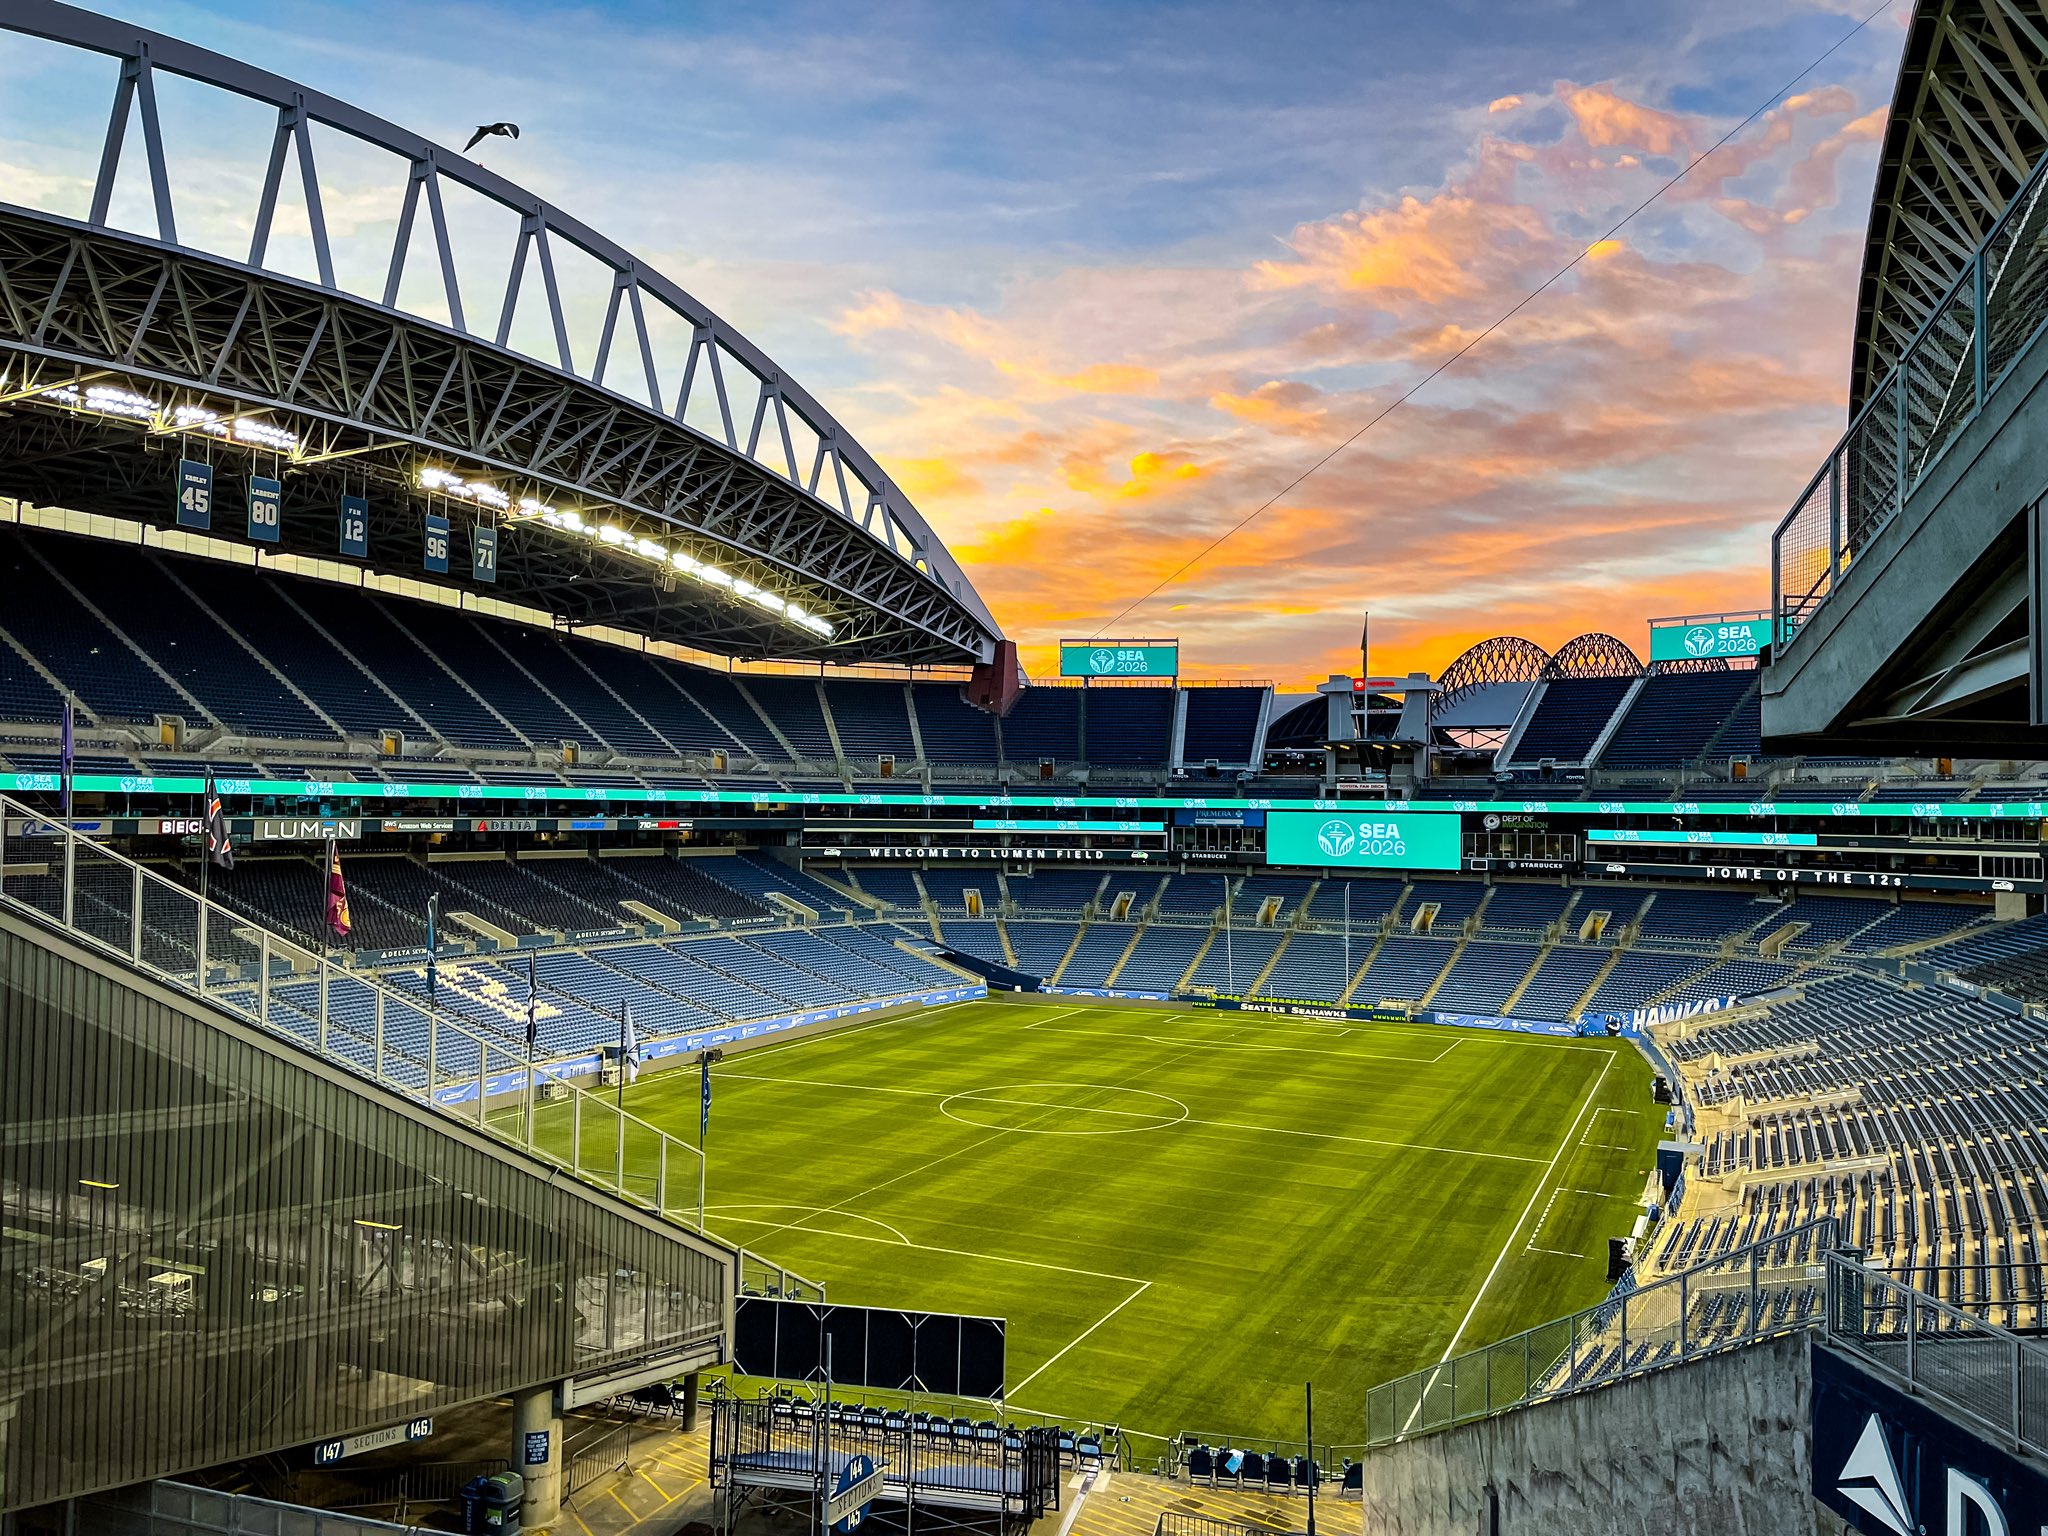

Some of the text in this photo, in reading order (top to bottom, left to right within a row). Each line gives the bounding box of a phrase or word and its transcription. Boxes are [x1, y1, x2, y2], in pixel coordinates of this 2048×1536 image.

[181, 487, 208, 513] 45
[252, 501, 276, 526] 80
[345, 519, 364, 542] 12
[427, 537, 447, 560] 96
[478, 548, 493, 570] 71
[1718, 626, 1752, 640] SEA
[1718, 638, 1756, 652] 2026
[1117, 651, 1144, 661] SEA
[1117, 662, 1148, 672] 2026
[264, 822, 355, 838] LUMEN
[491, 821, 531, 830] DELTA
[1359, 823, 1400, 839] SEA
[870, 849, 1103, 859] WELCOME TO LUMEN FIELD
[1359, 840, 1406, 856] 2026
[1707, 867, 1901, 886] HOME OF THE 12s
[388, 949, 410, 957] DELTA
[1240, 1003, 1347, 1018] SEATTLE SEAHAWKS
[323, 1420, 428, 1461] 147 SECTIONS 146
[850, 1457, 862, 1481] 144
[838, 1480, 877, 1514] SECTIONS
[848, 1510, 860, 1530] 145
